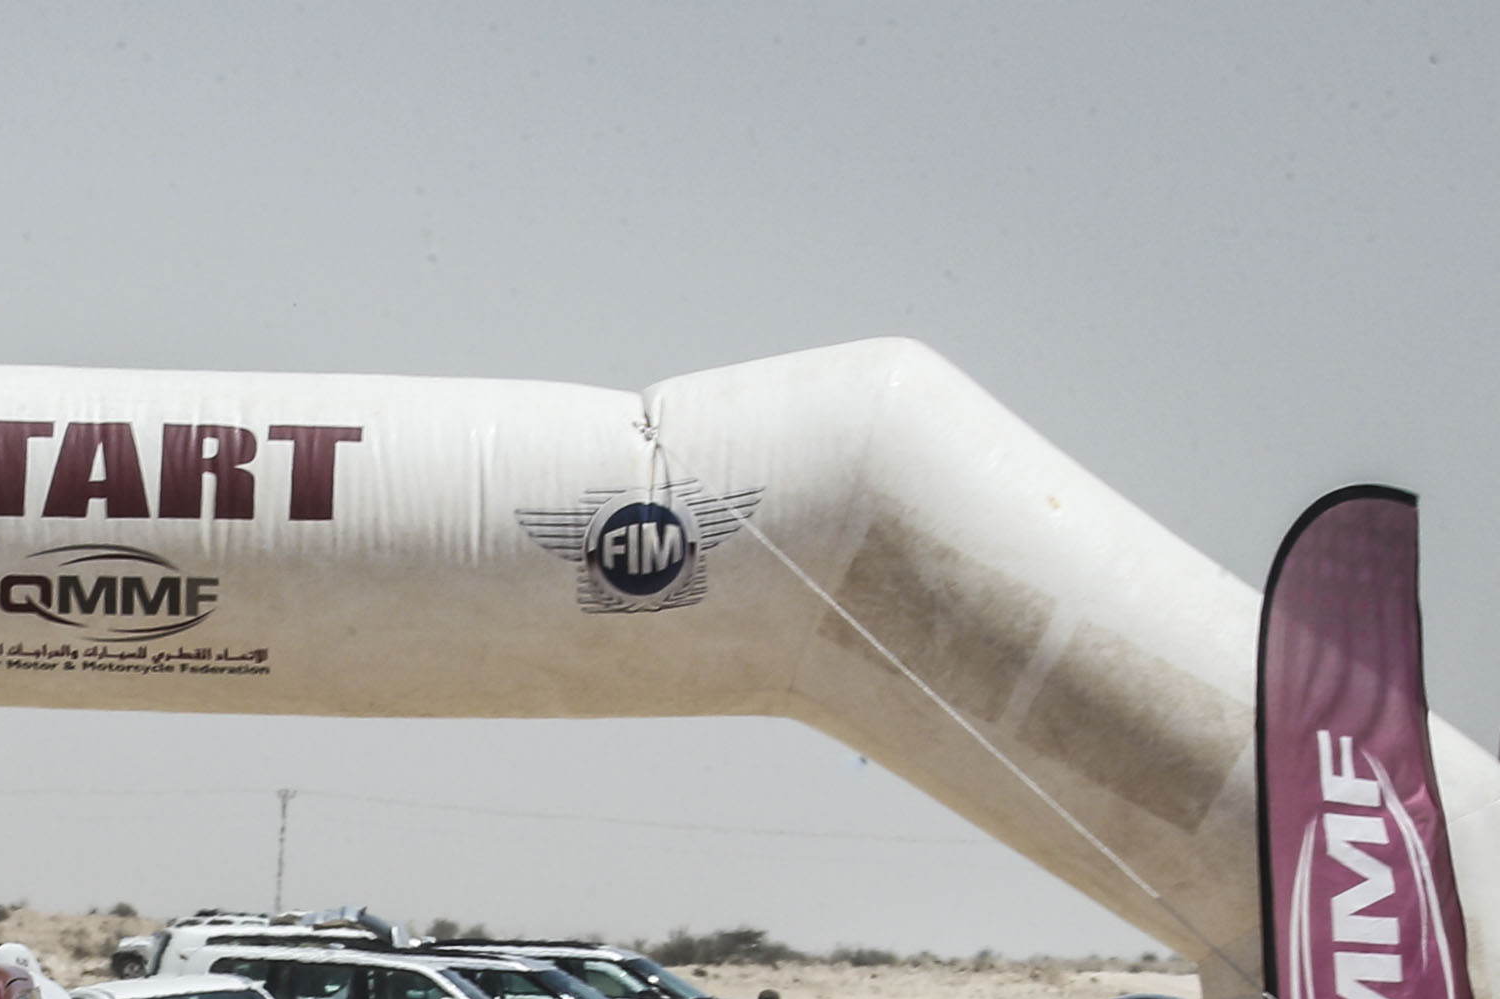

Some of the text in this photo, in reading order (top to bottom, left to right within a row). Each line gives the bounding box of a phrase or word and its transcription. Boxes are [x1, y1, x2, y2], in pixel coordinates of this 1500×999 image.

[601, 521, 684, 575] FIM
[0, 574, 220, 626] QMMF
[7, 658, 57, 671] Motor
[63, 660, 76, 671] &
[82, 660, 175, 676] Motorcycle
